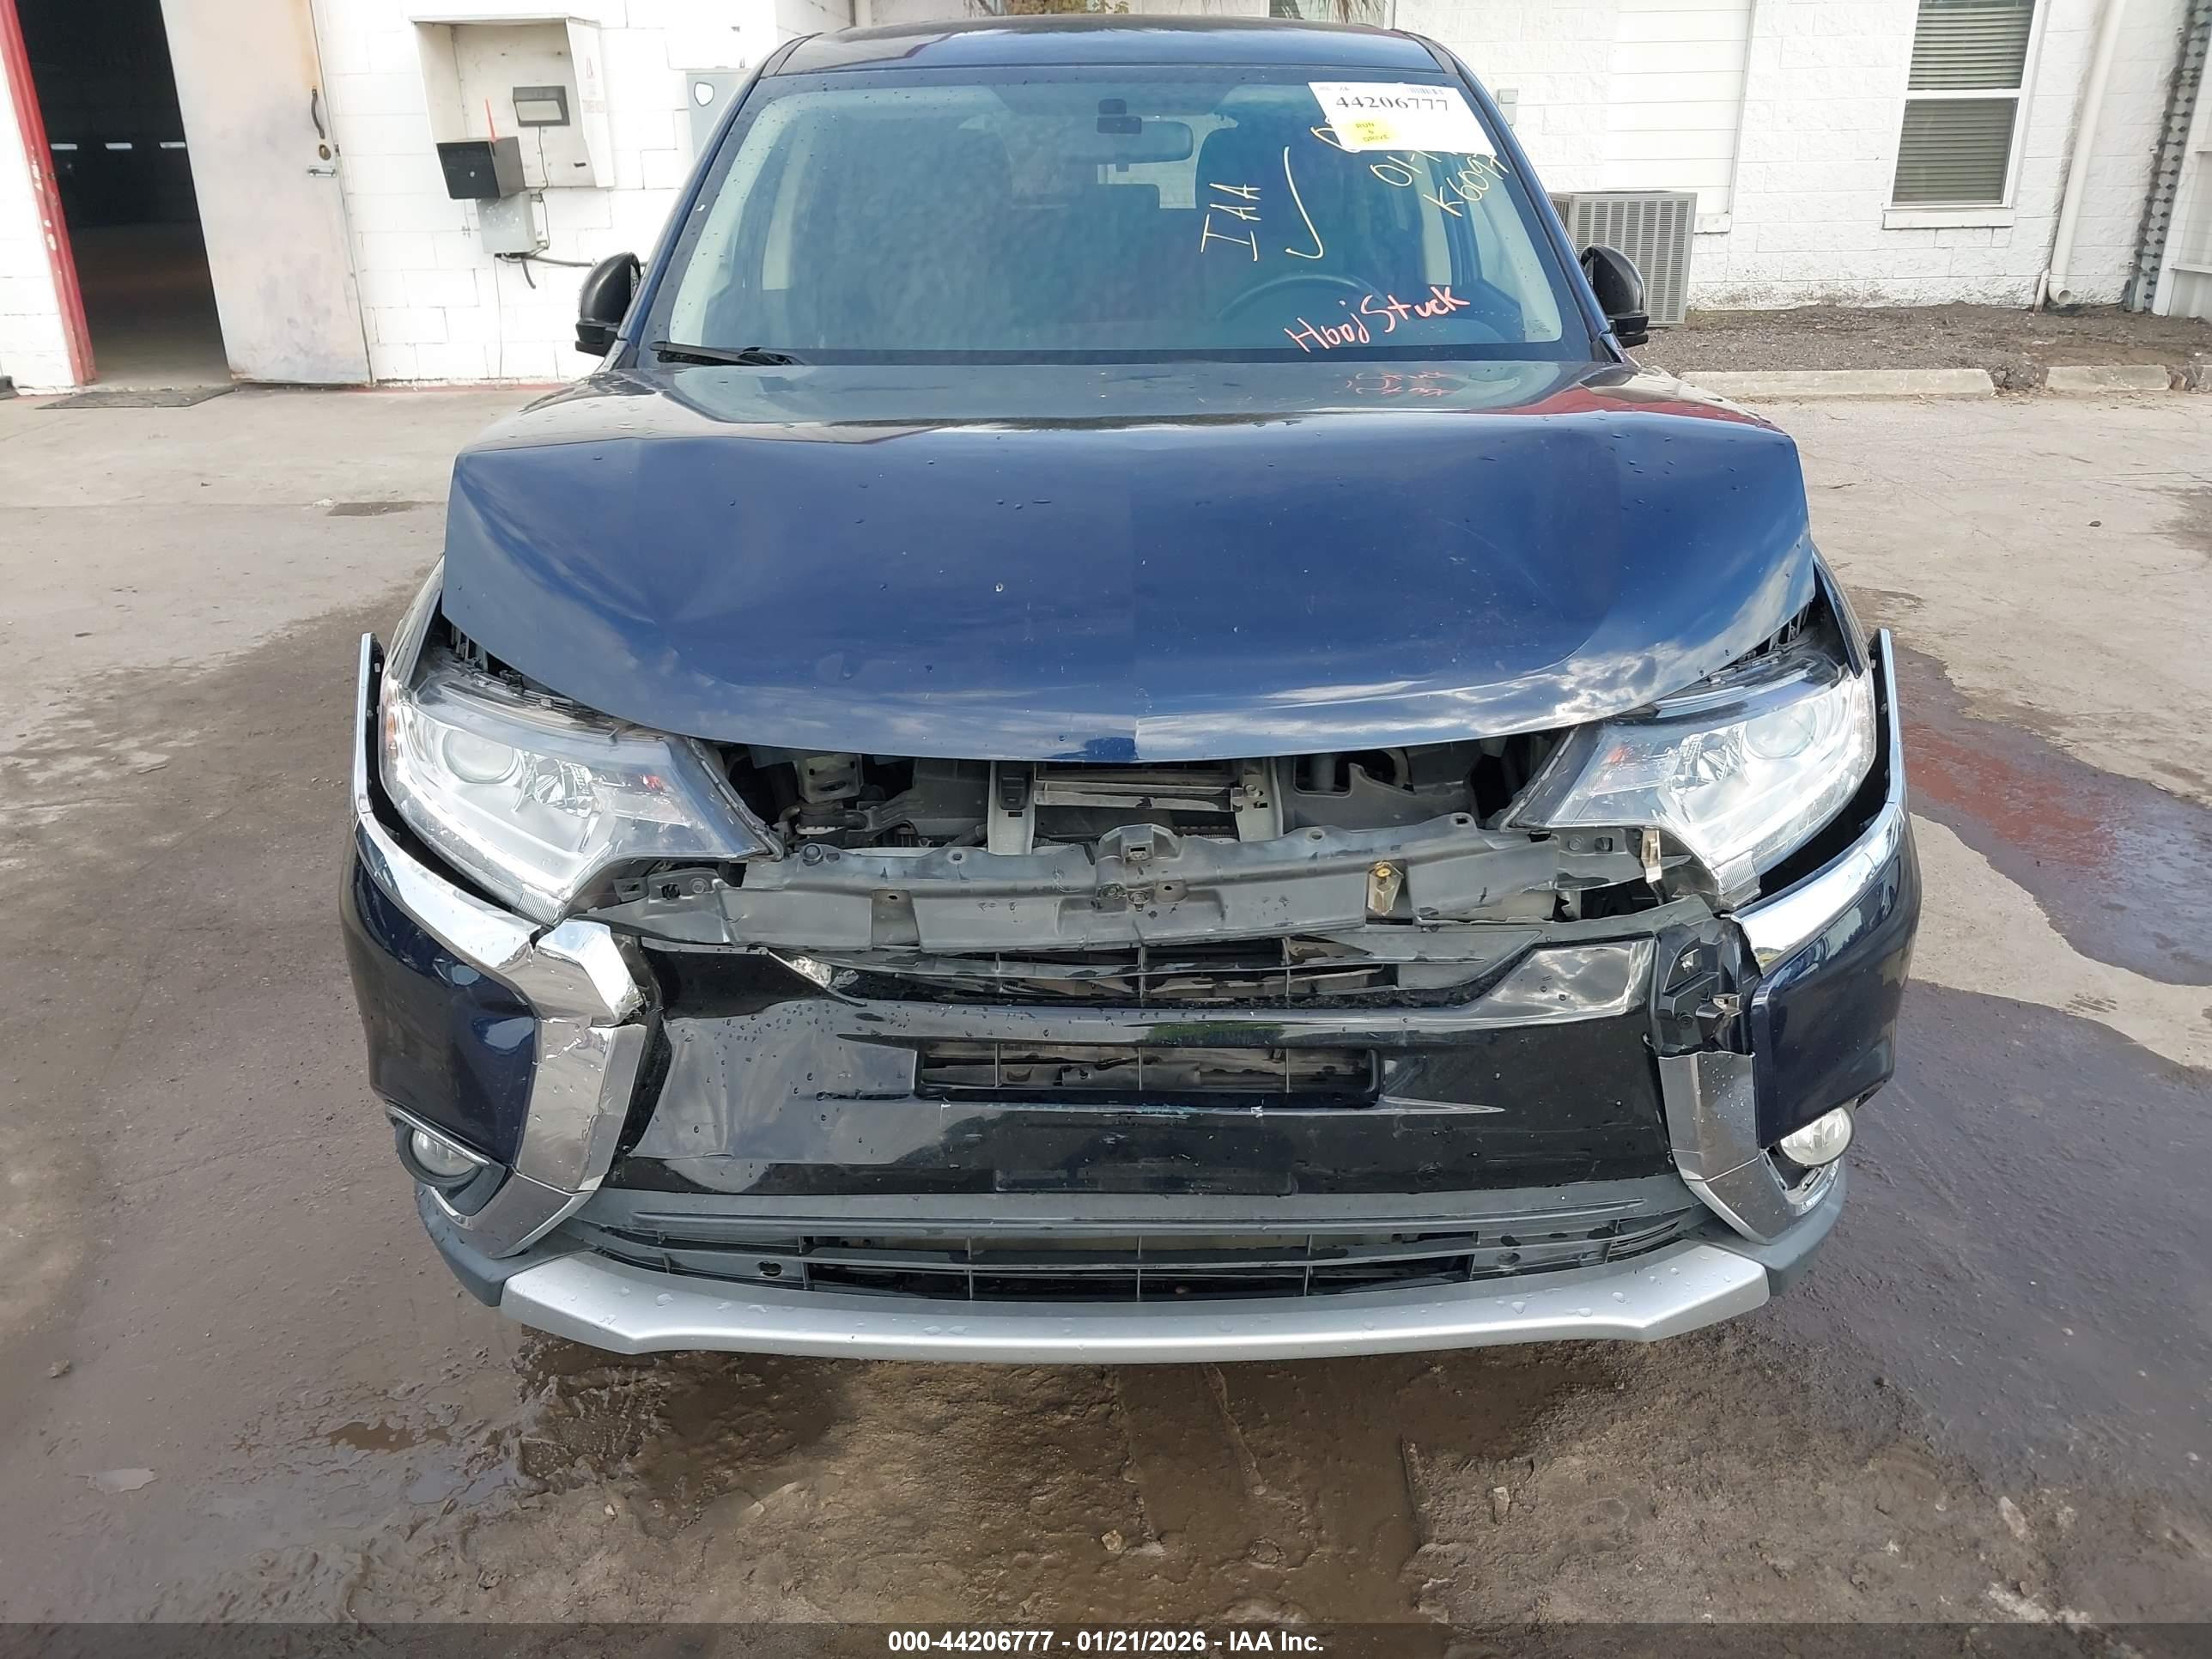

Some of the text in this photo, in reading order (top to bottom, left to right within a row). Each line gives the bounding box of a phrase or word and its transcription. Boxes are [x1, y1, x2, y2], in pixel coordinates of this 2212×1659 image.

[1335, 96, 1448, 111] 44206777
[1201, 183, 1261, 261] IAA
[1360, 286, 1471, 334] Stuck
